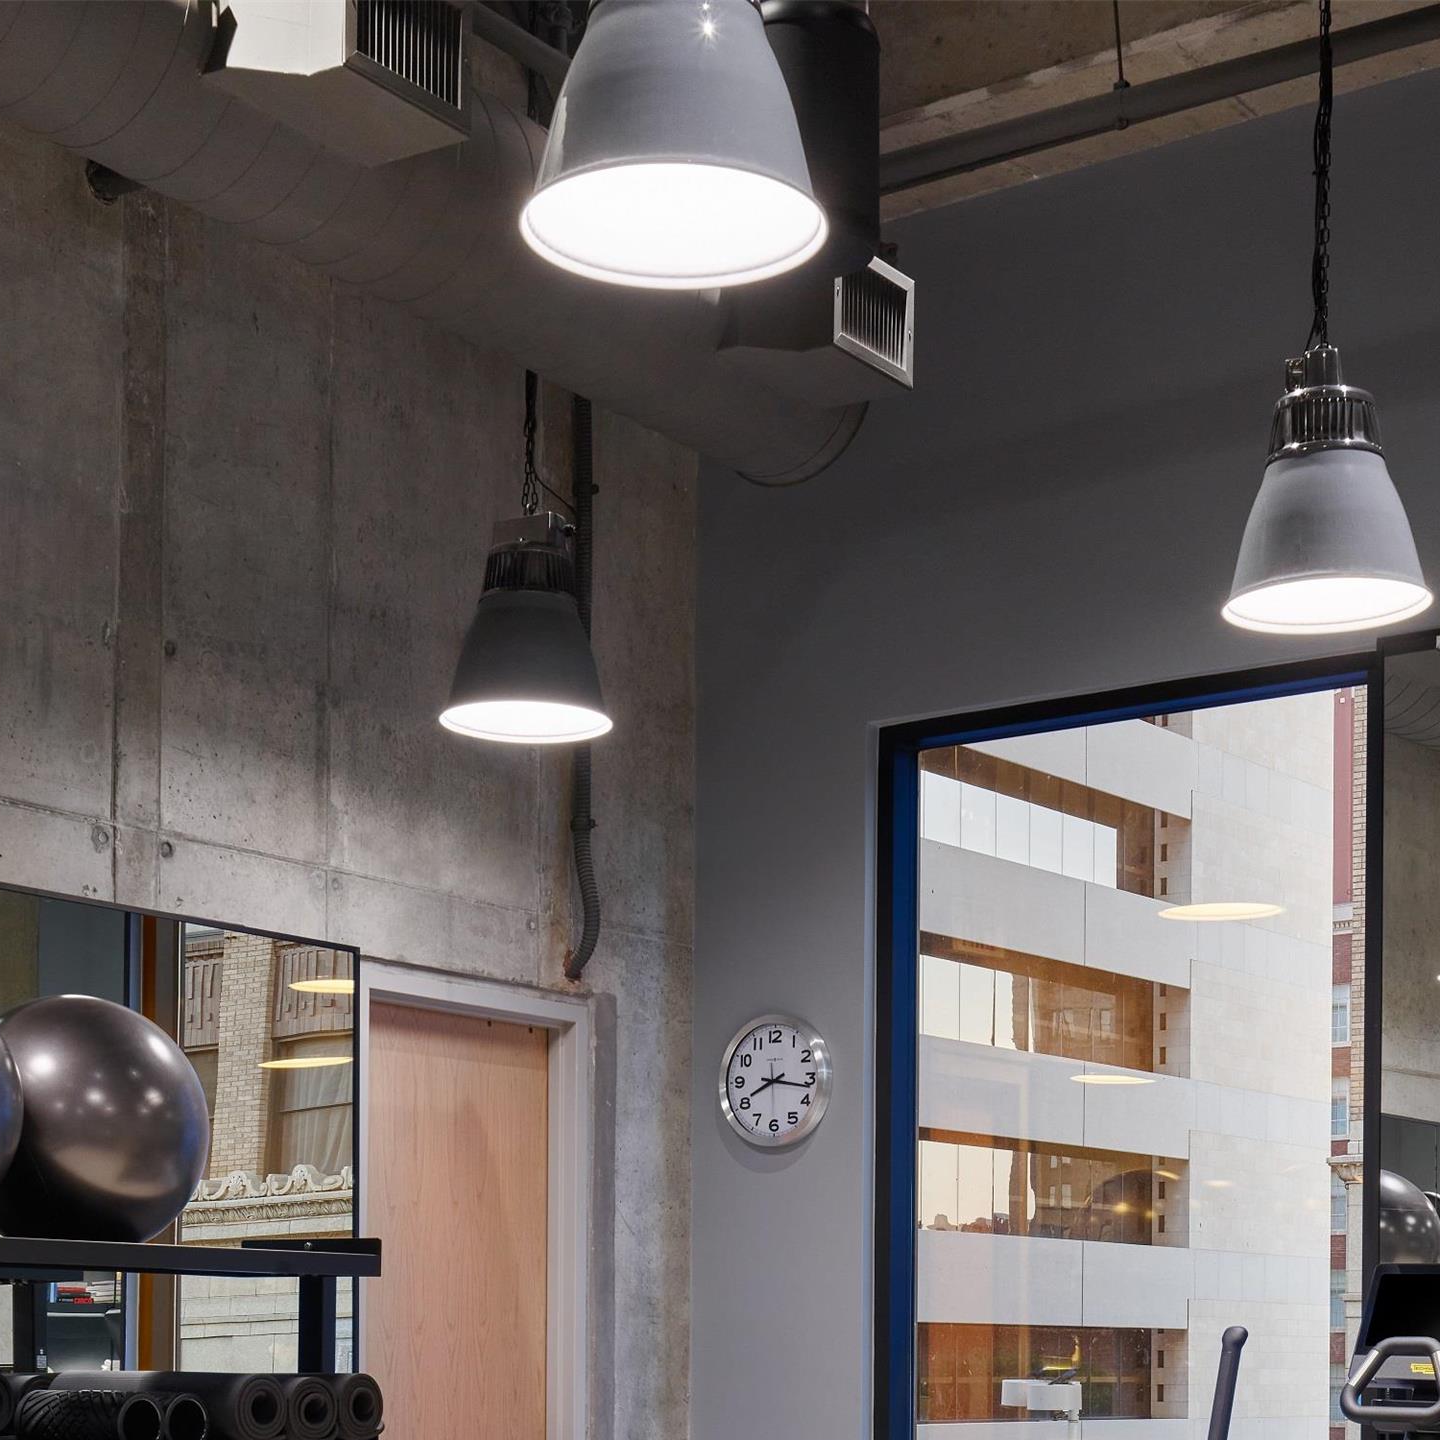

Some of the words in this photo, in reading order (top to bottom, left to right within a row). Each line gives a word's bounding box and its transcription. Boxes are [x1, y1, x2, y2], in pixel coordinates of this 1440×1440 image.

[768, 1030, 782, 1043] 12
[792, 1035, 796, 1048] 1
[753, 1037, 762, 1050] 11
[740, 1054, 752, 1067] 10
[801, 1050, 811, 1063] 2
[735, 1076, 745, 1088] 9
[804, 1072, 815, 1085] 3
[740, 1097, 751, 1110] 8
[800, 1094, 810, 1106] 4
[752, 1113, 762, 1126] 7
[787, 1112, 798, 1125] 5
[769, 1119, 779, 1132] 6
